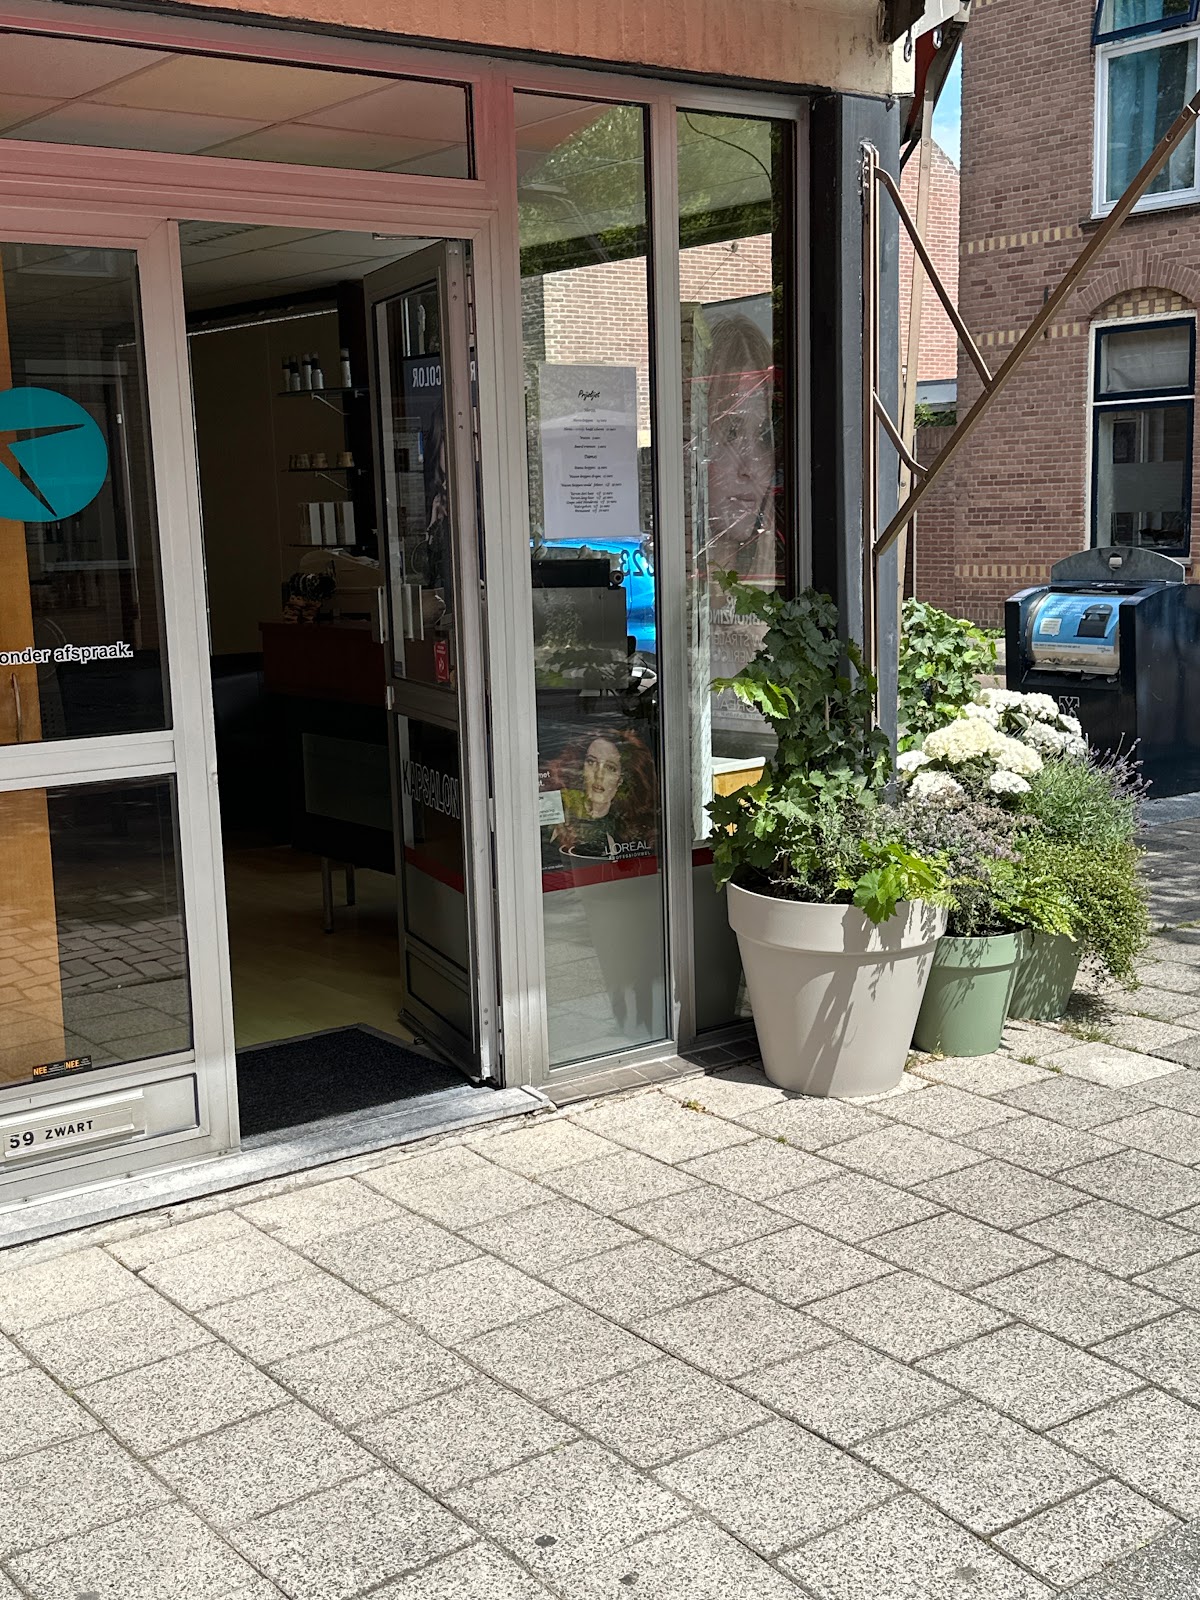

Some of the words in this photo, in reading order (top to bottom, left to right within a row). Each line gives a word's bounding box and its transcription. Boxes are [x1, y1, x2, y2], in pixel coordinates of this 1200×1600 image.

[0, 646, 51, 666] onder
[53, 640, 134, 665] afspraak.
[401, 760, 461, 820] KAPSALON
[33, 1066, 48, 1076] NEE
[65, 1059, 80, 1069] NEE
[9, 1131, 35, 1149] 59
[45, 1120, 94, 1140] ZWART
